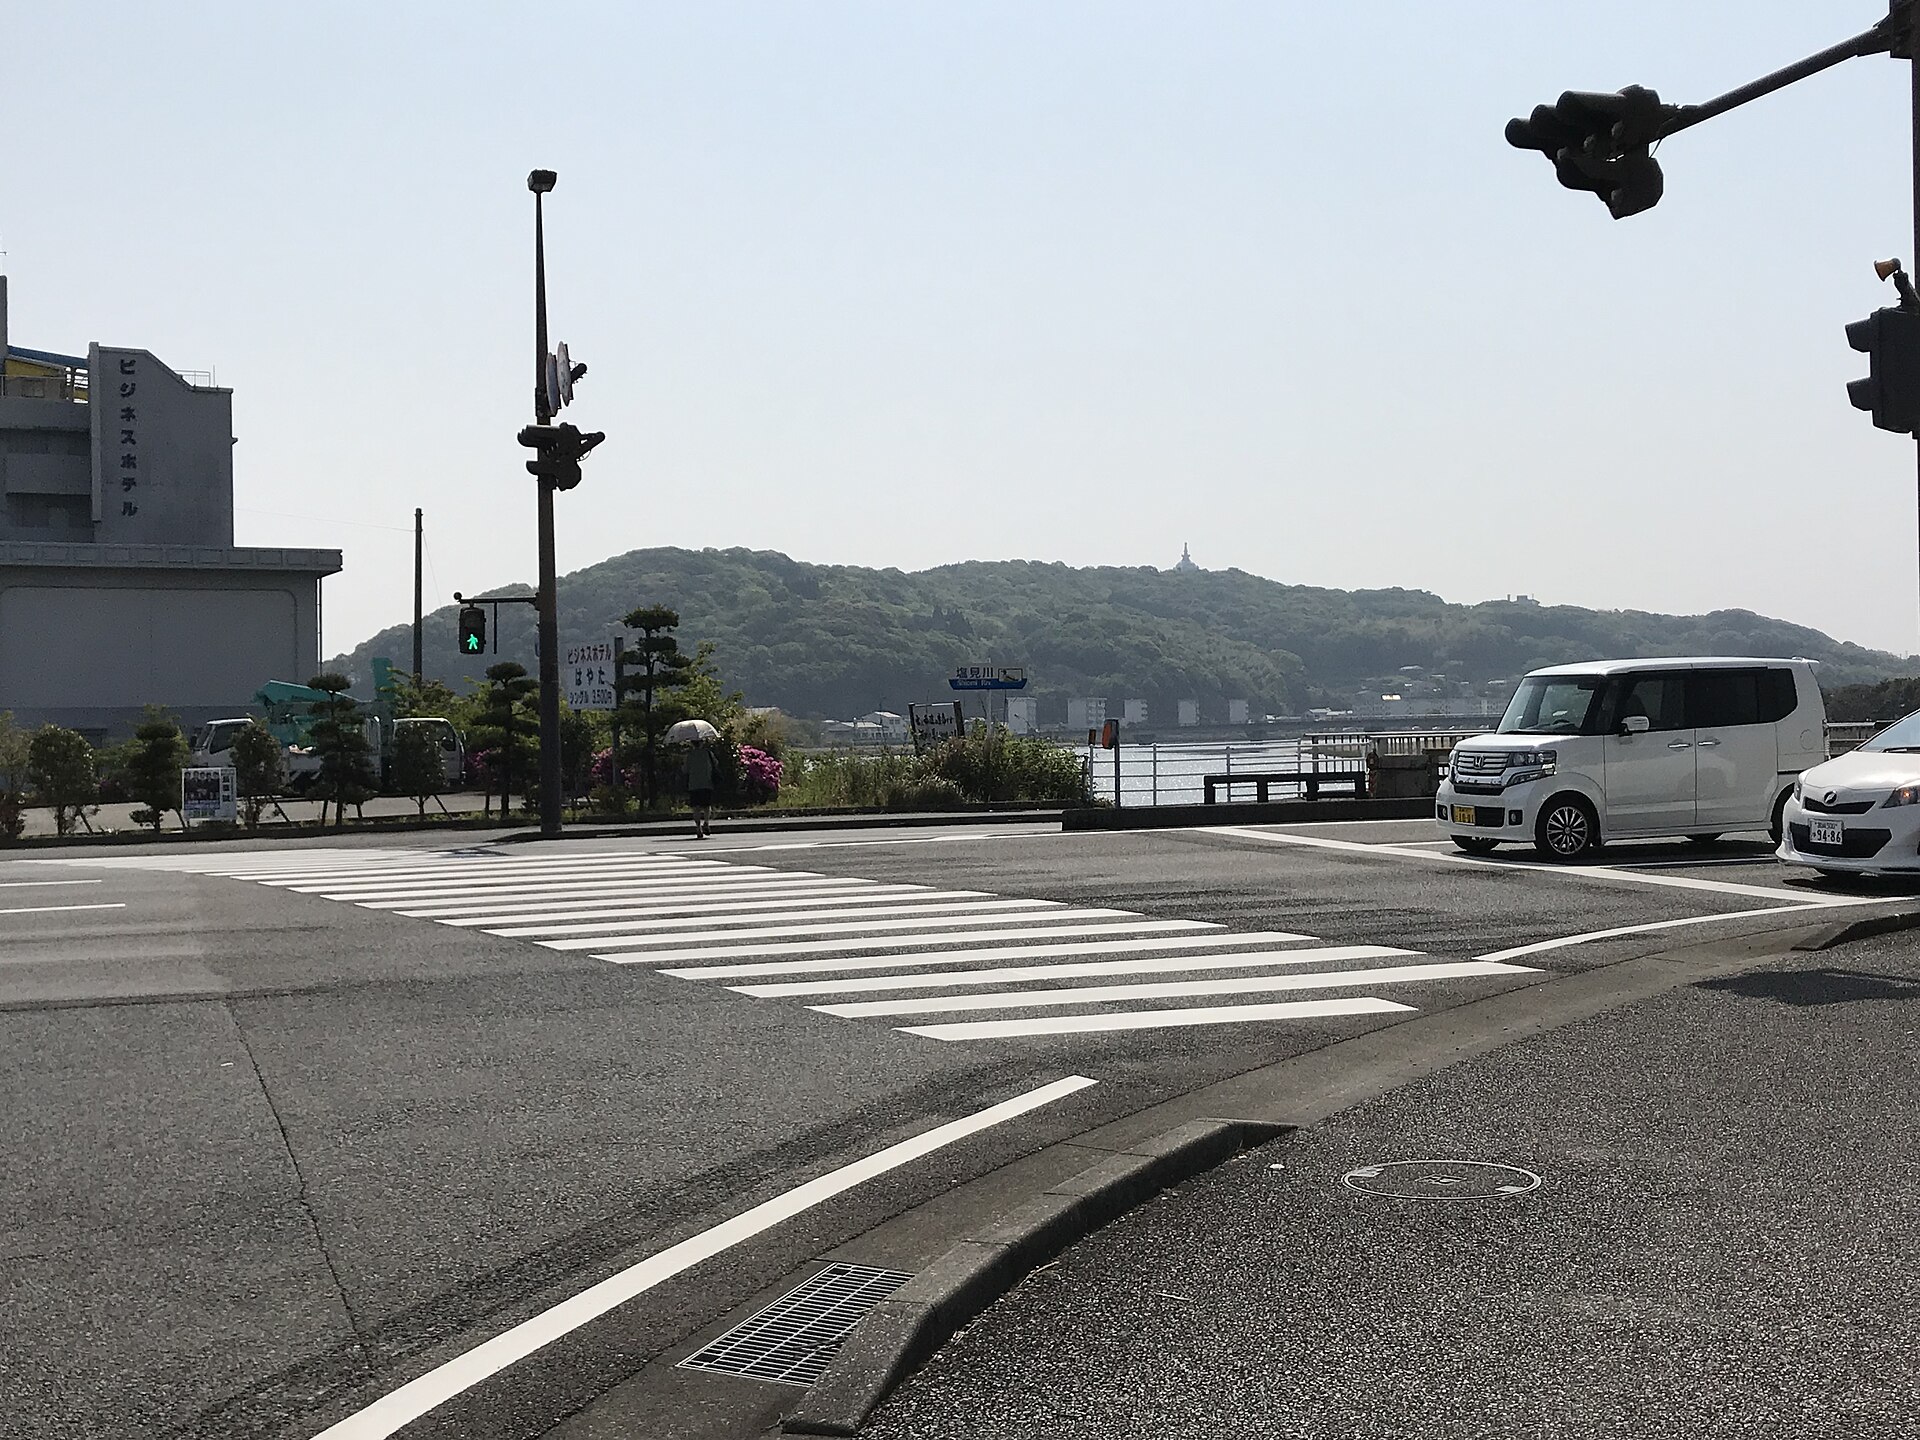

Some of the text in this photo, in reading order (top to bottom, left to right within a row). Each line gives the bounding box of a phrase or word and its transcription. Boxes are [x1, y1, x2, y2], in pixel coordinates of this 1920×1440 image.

[119, 358, 138, 517] ビジネスホテル
[956, 666, 994, 679] 塩見川
